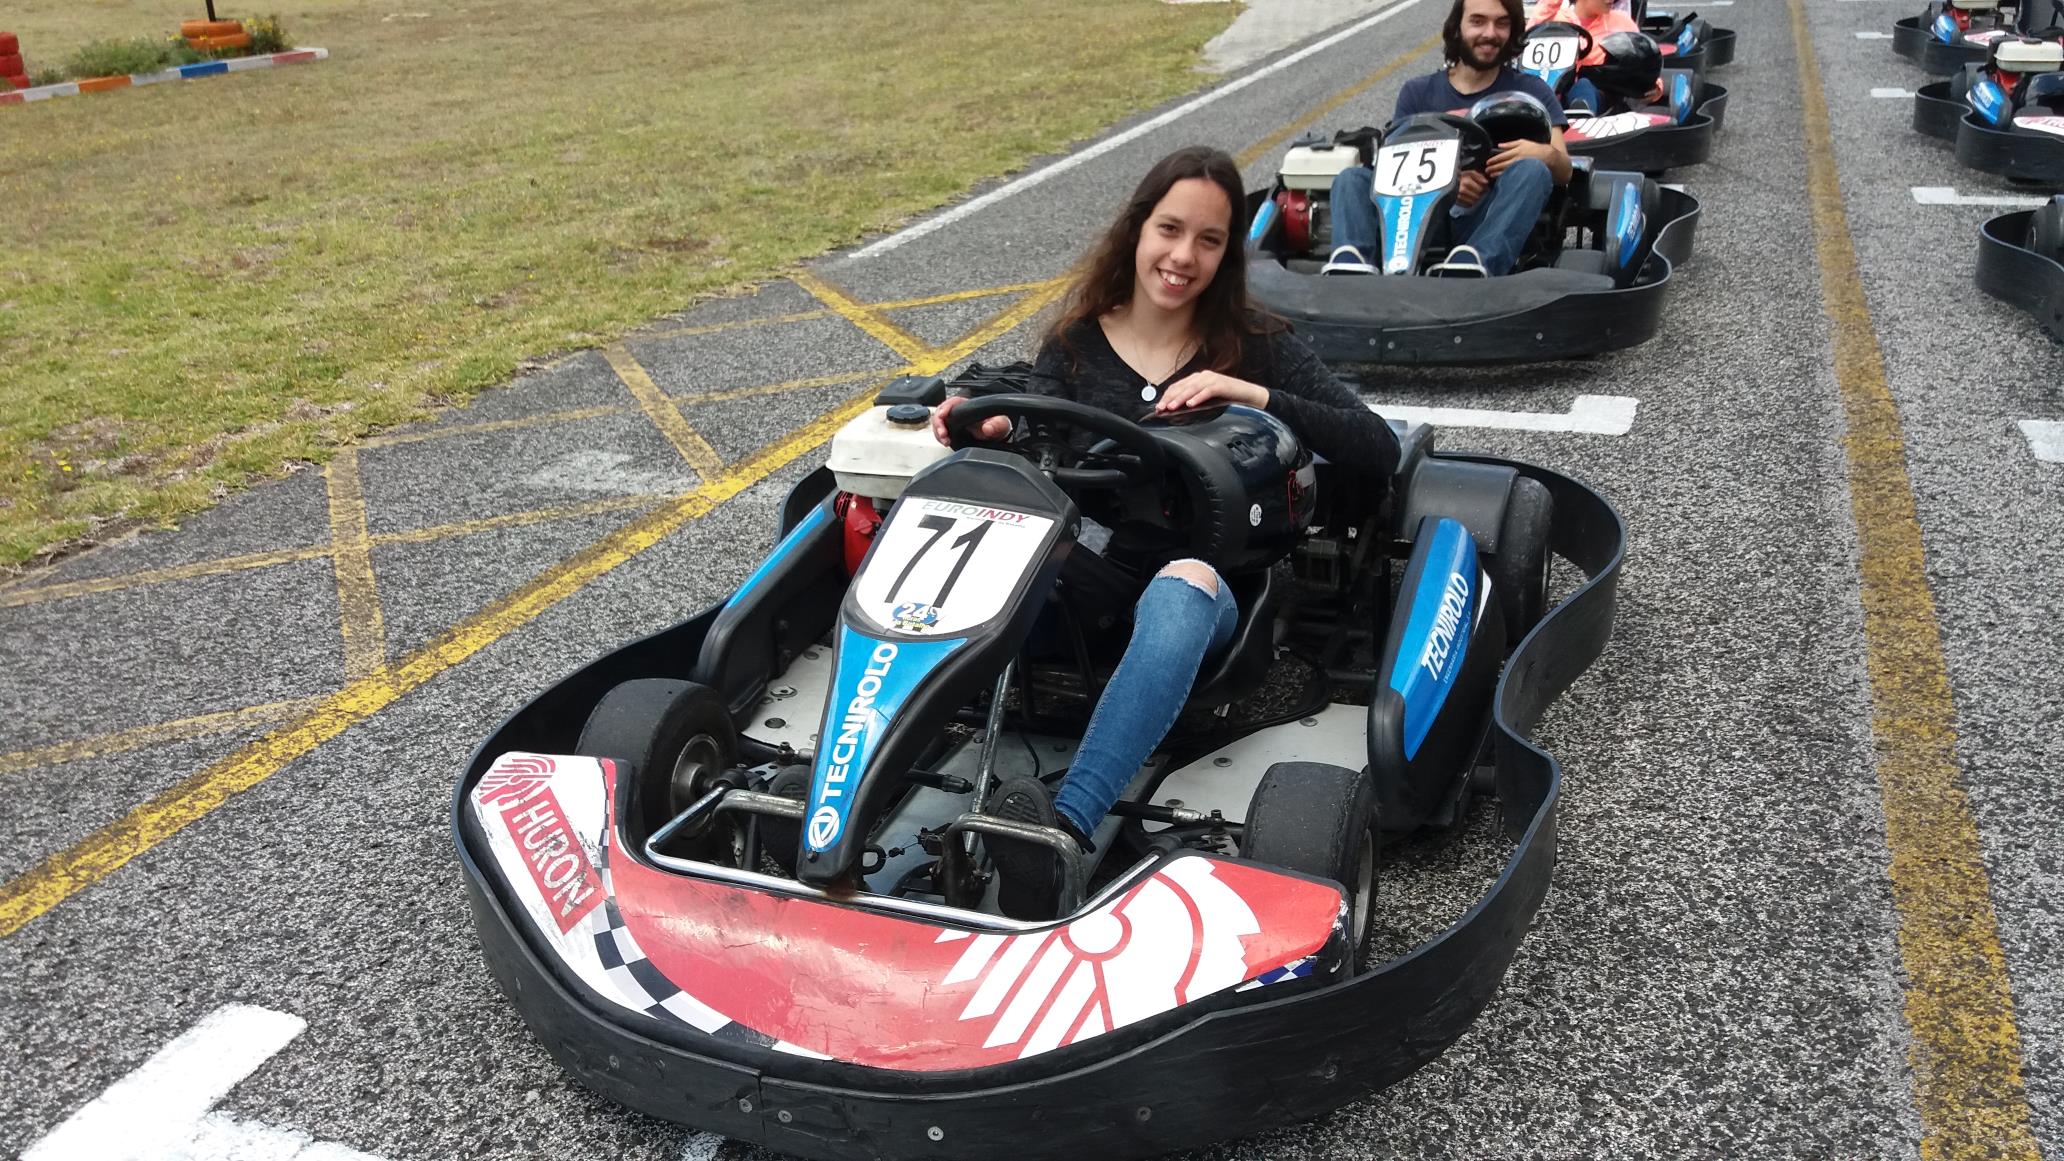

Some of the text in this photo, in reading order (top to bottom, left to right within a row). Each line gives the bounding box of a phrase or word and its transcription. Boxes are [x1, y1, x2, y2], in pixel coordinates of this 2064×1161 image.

[1532, 42, 1561, 64] 60
[1392, 148, 1437, 186] 75
[922, 502, 1031, 523] EUROINDY
[884, 514, 994, 608] 71
[1421, 571, 1469, 681] TECNIROLO
[820, 643, 898, 803] TECNIROLO
[512, 799, 595, 918] HURON
